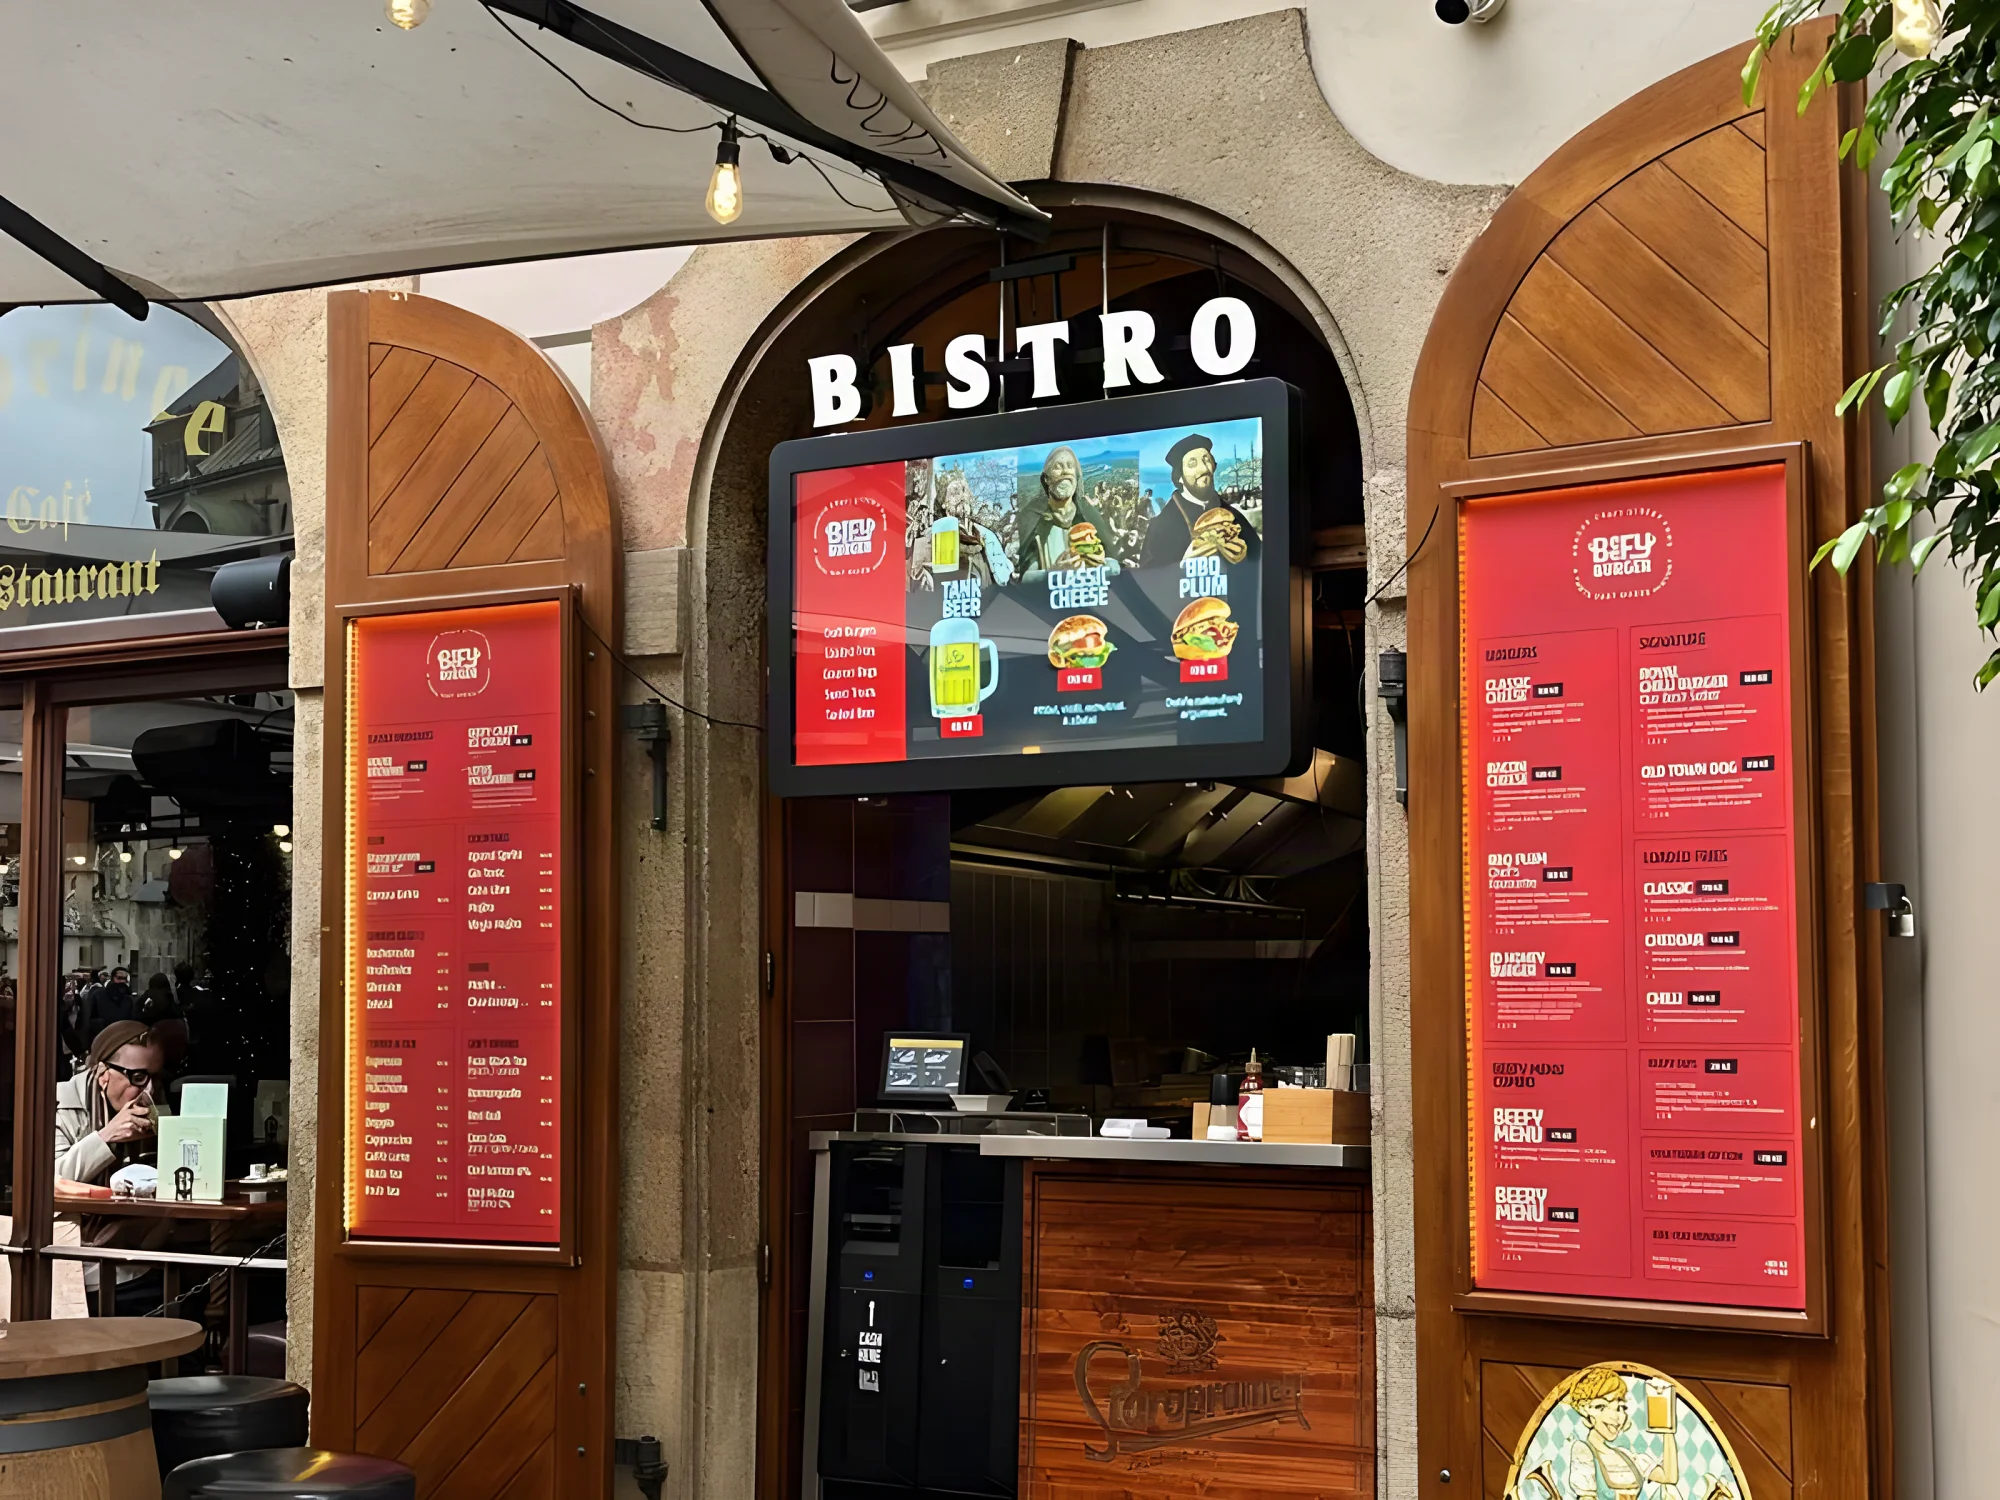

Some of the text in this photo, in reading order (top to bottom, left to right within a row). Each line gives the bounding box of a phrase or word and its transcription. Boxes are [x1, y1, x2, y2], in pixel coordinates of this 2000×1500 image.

[808, 297, 1257, 428] BISTRO
[1047, 566, 1111, 590] CLASSIC
[1179, 574, 1228, 599] PLUM
[1050, 585, 1109, 610] CHEESE
[942, 598, 981, 618] BEER
[1493, 1107, 1544, 1126] BEEFY
[1493, 1124, 1543, 1143] MENU
[1495, 1186, 1548, 1205] BEERY
[1495, 1203, 1544, 1223] MENU
